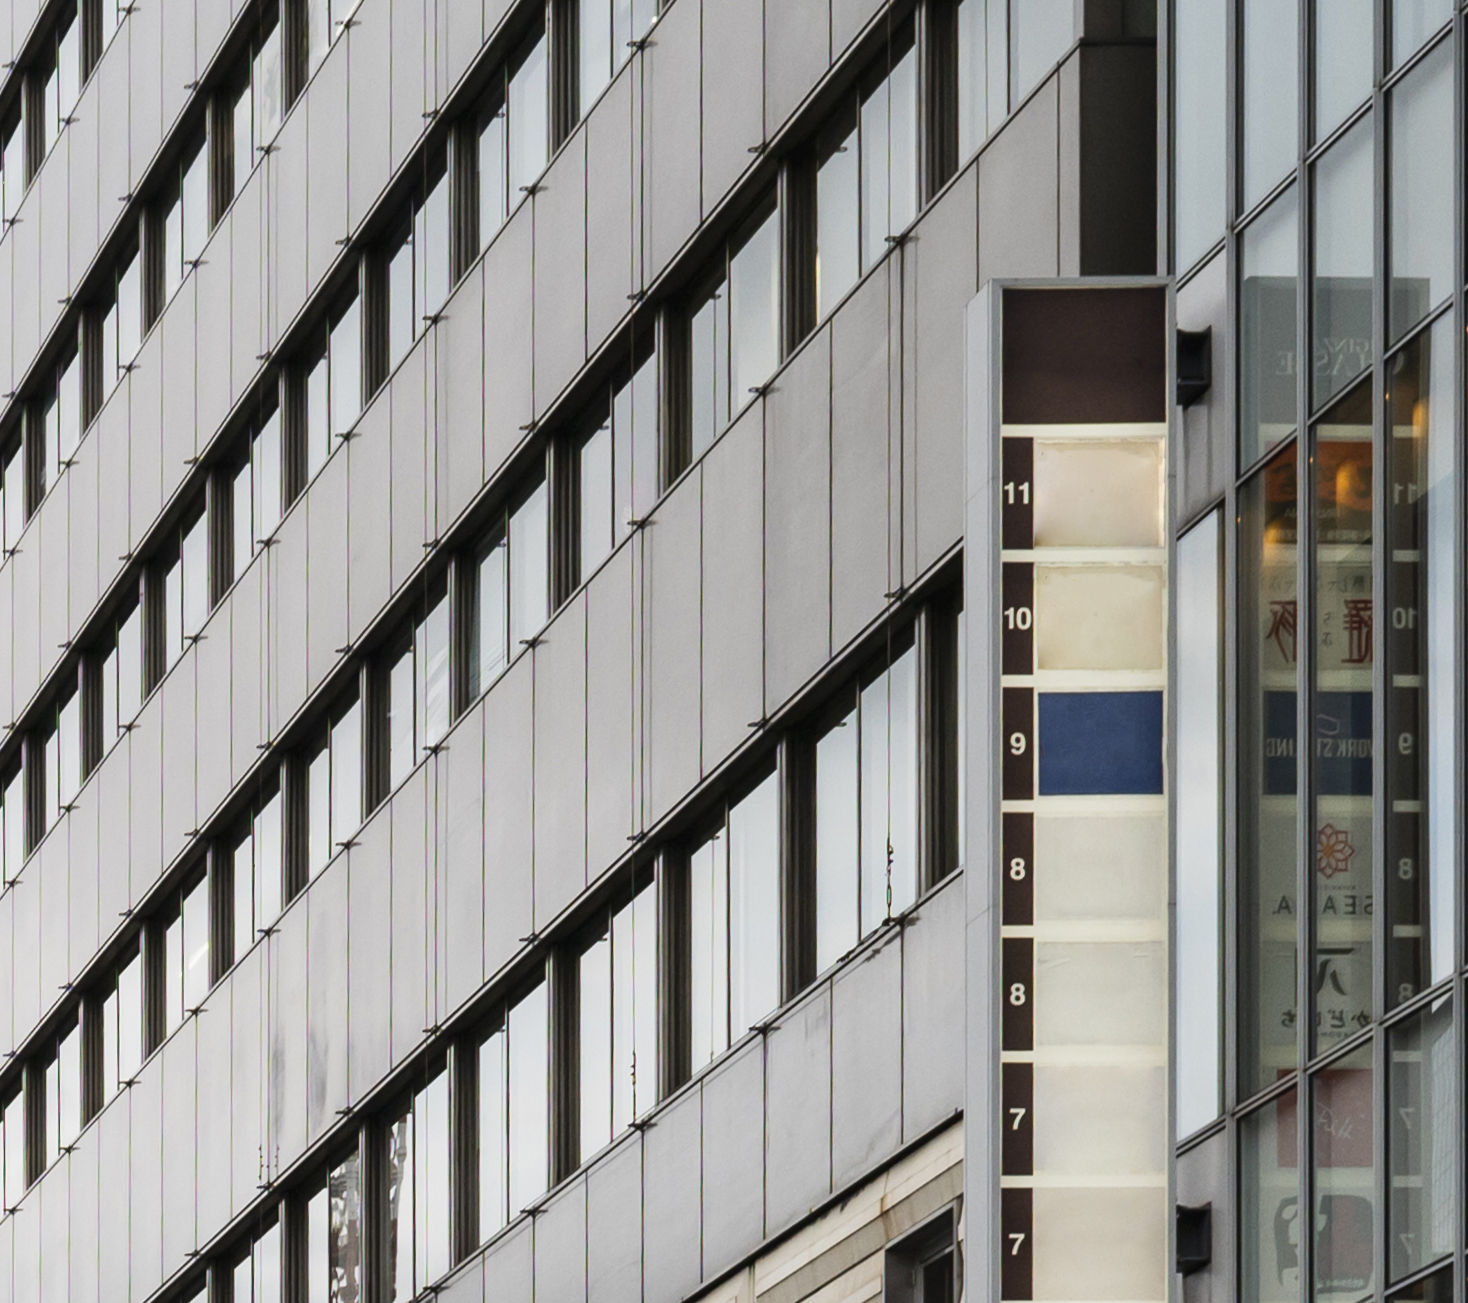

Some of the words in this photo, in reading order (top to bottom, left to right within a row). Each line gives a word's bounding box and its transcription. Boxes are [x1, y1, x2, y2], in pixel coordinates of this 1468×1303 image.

[1003, 482, 1029, 504] 11
[1004, 607, 1031, 630] 10
[1010, 733, 1026, 755] 9
[1010, 859, 1026, 880] 8
[1010, 983, 1026, 1005] 8
[1009, 1109, 1025, 1130] 7
[1009, 1234, 1025, 1255] 7
